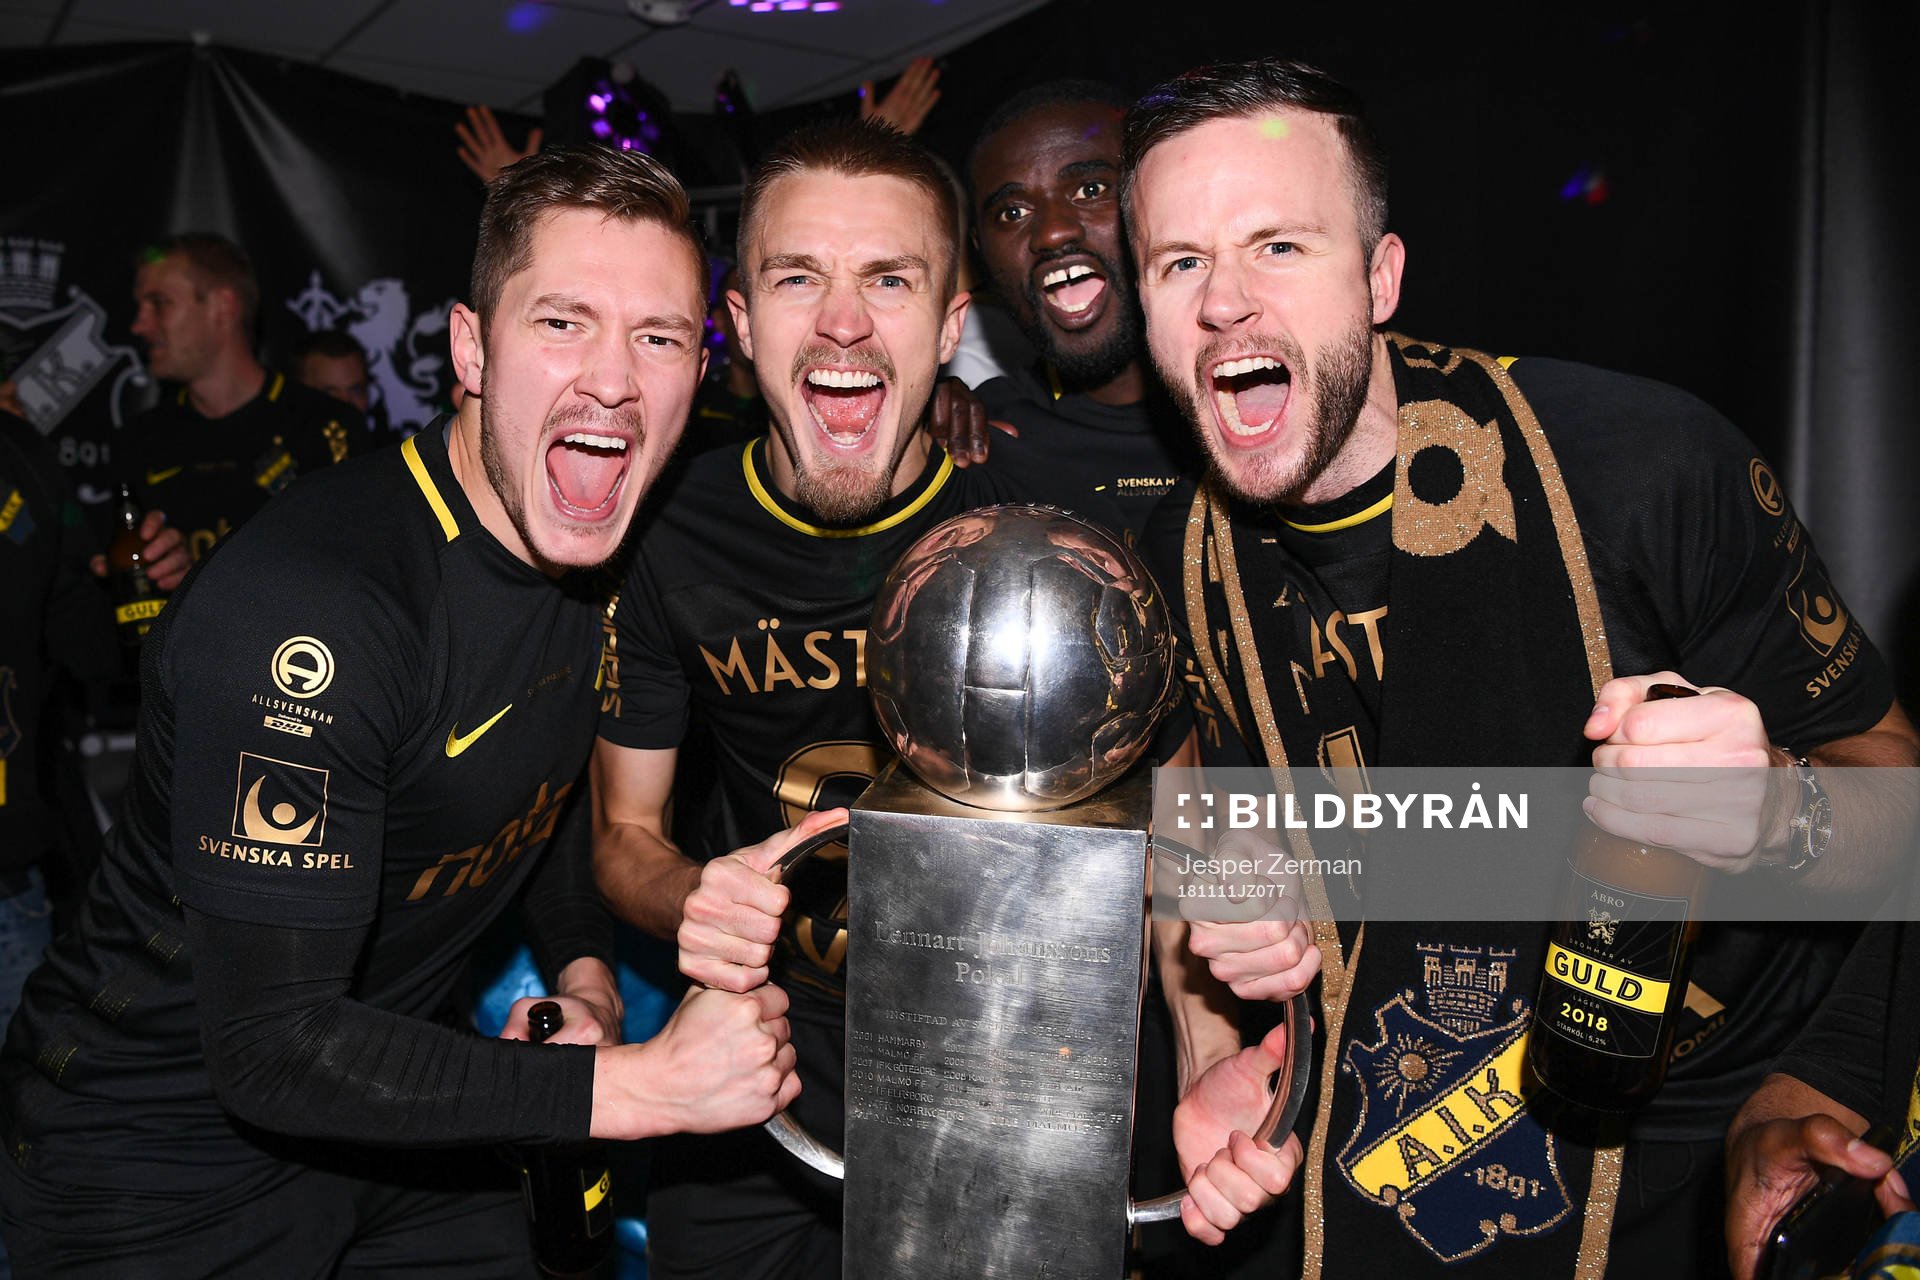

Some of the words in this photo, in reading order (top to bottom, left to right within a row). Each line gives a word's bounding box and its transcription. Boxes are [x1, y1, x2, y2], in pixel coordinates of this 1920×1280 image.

[1117, 478, 1163, 487] SVENSKA
[252, 694, 333, 724] ALLSVENSKAN
[270, 719, 305, 734] DHL
[198, 834, 293, 867] SVENSKA
[302, 852, 354, 870] SPEL
[873, 921, 965, 951] Lennart
[1554, 952, 1643, 1001] GULD
[1560, 1002, 1608, 1032] 2018
[1573, 995, 1600, 1009] LAGER
[885, 1010, 948, 1026] INSTIFTAD
[1472, 1163, 1541, 1199] 1891
